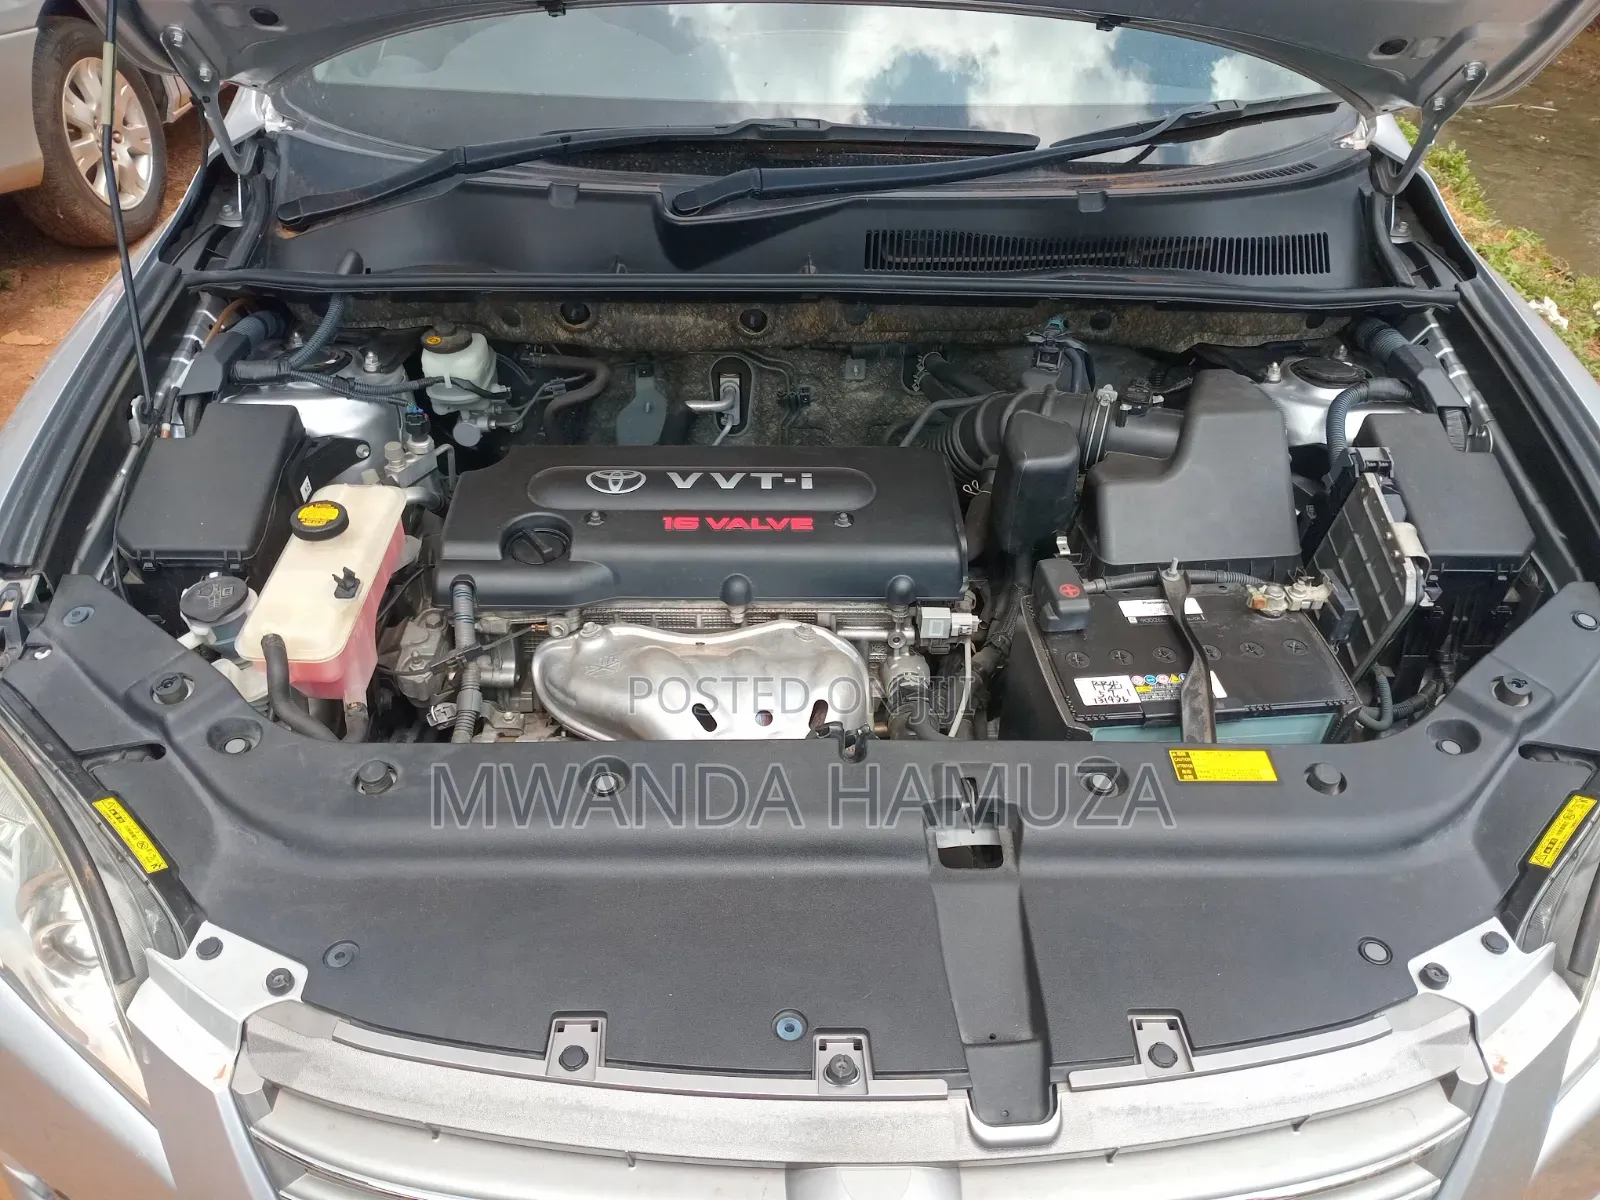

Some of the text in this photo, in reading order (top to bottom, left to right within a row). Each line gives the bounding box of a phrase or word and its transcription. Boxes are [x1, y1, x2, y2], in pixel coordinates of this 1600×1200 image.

[666, 472, 813, 490] VVT-i
[662, 516, 814, 531] 16 VALVE
